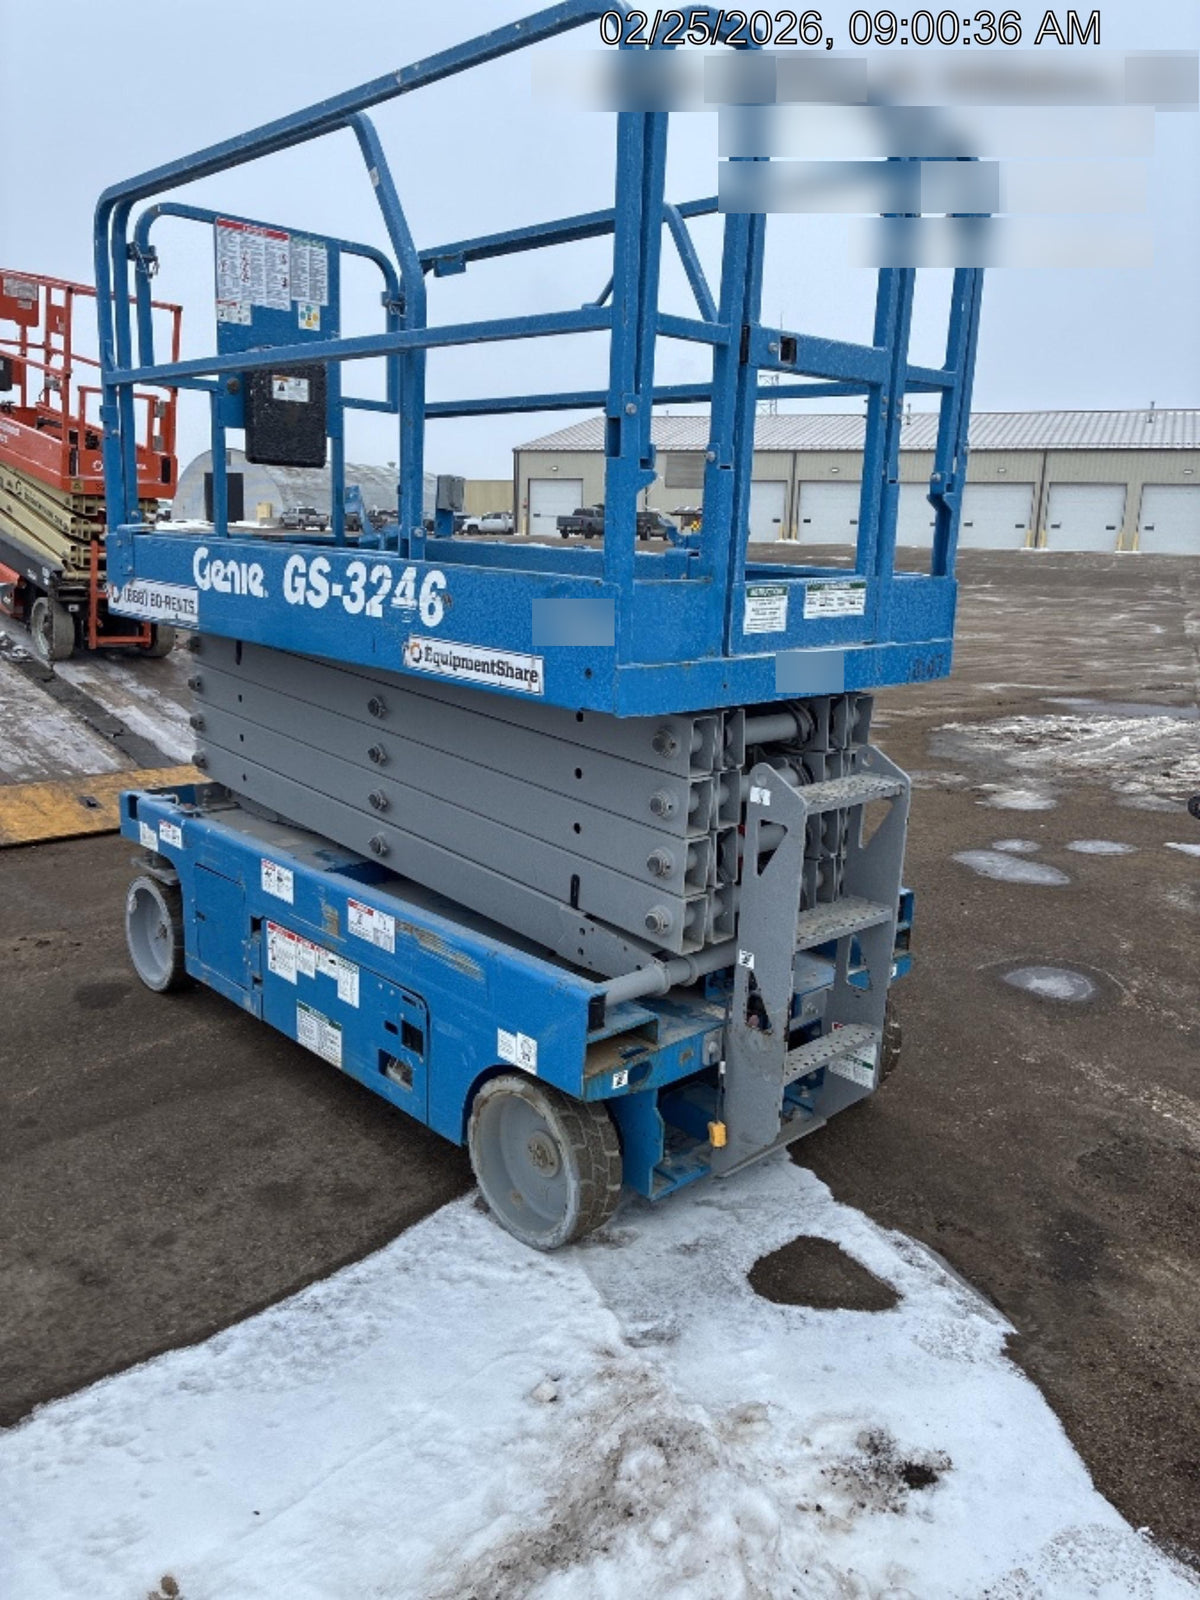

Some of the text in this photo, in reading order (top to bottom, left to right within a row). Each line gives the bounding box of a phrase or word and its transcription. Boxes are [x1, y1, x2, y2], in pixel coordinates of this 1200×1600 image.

[193, 547, 264, 598] Genie
[283, 554, 447, 627] GS-3246
[424, 644, 538, 683] EquipmentShare
